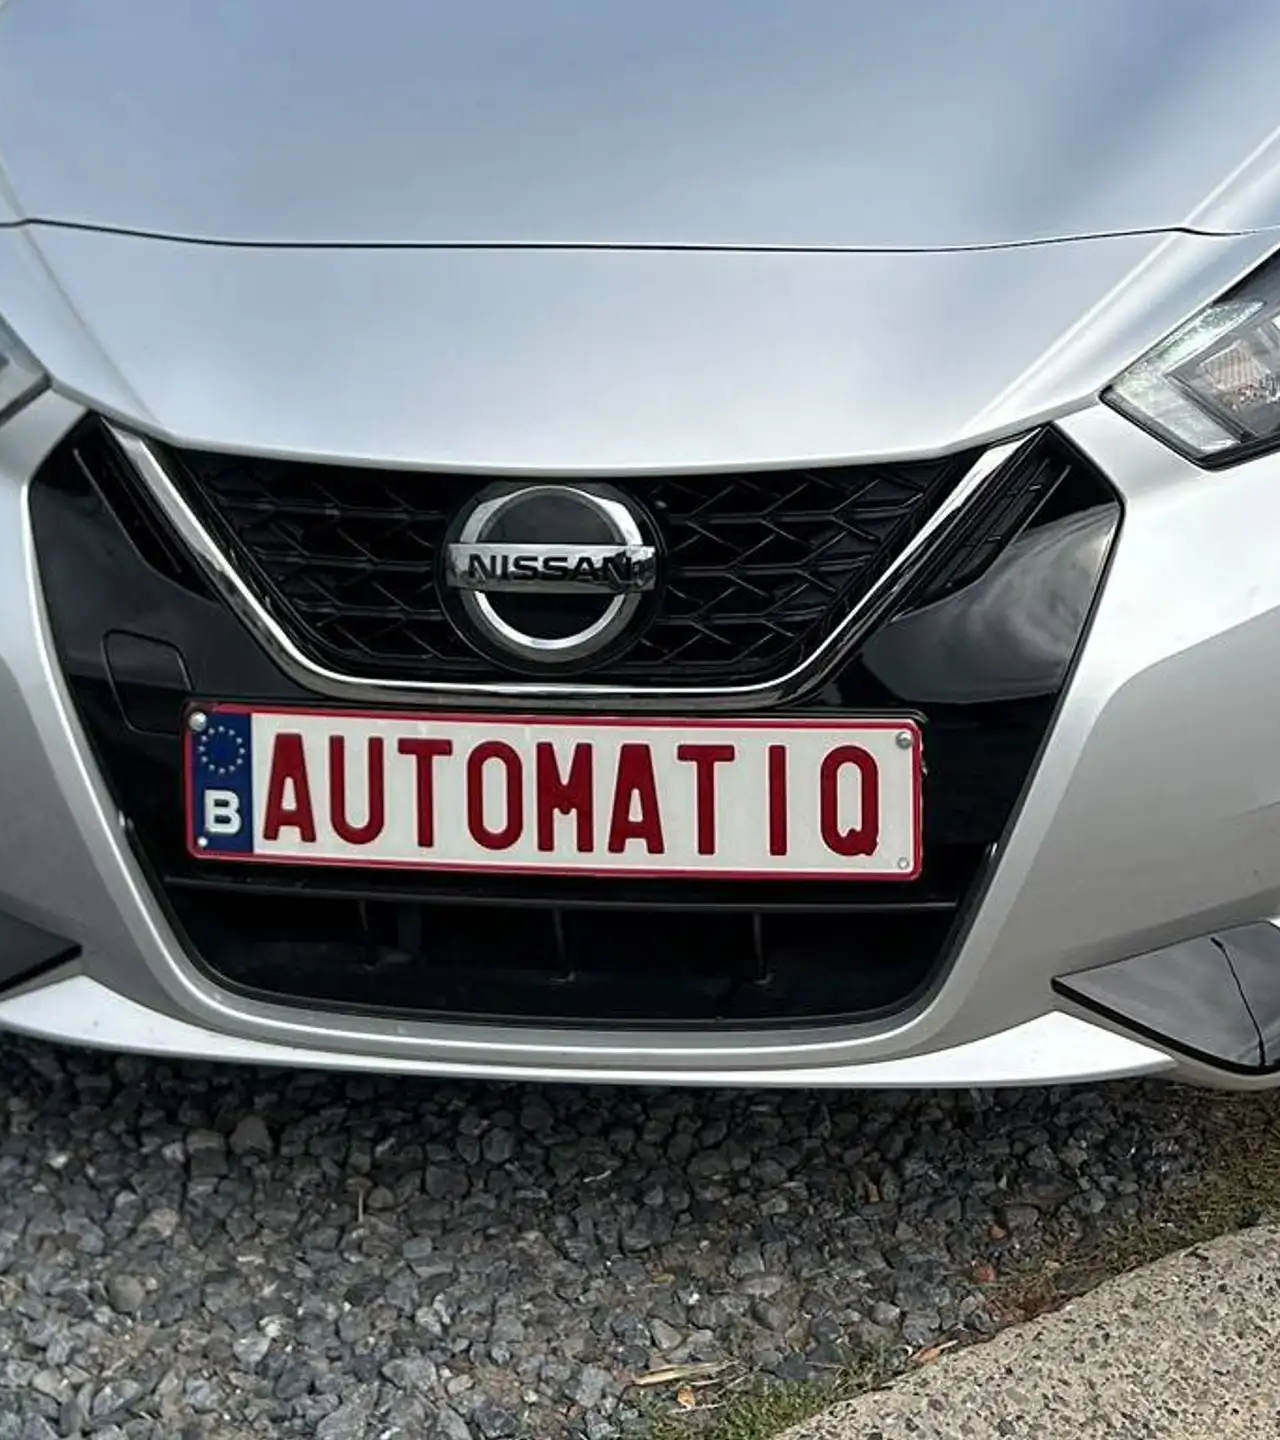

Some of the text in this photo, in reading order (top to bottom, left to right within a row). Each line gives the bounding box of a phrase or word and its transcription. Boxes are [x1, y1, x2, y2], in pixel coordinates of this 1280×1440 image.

[467, 553, 633, 581] NISSAN
[203, 732, 880, 857] B AUTOMATIQ
